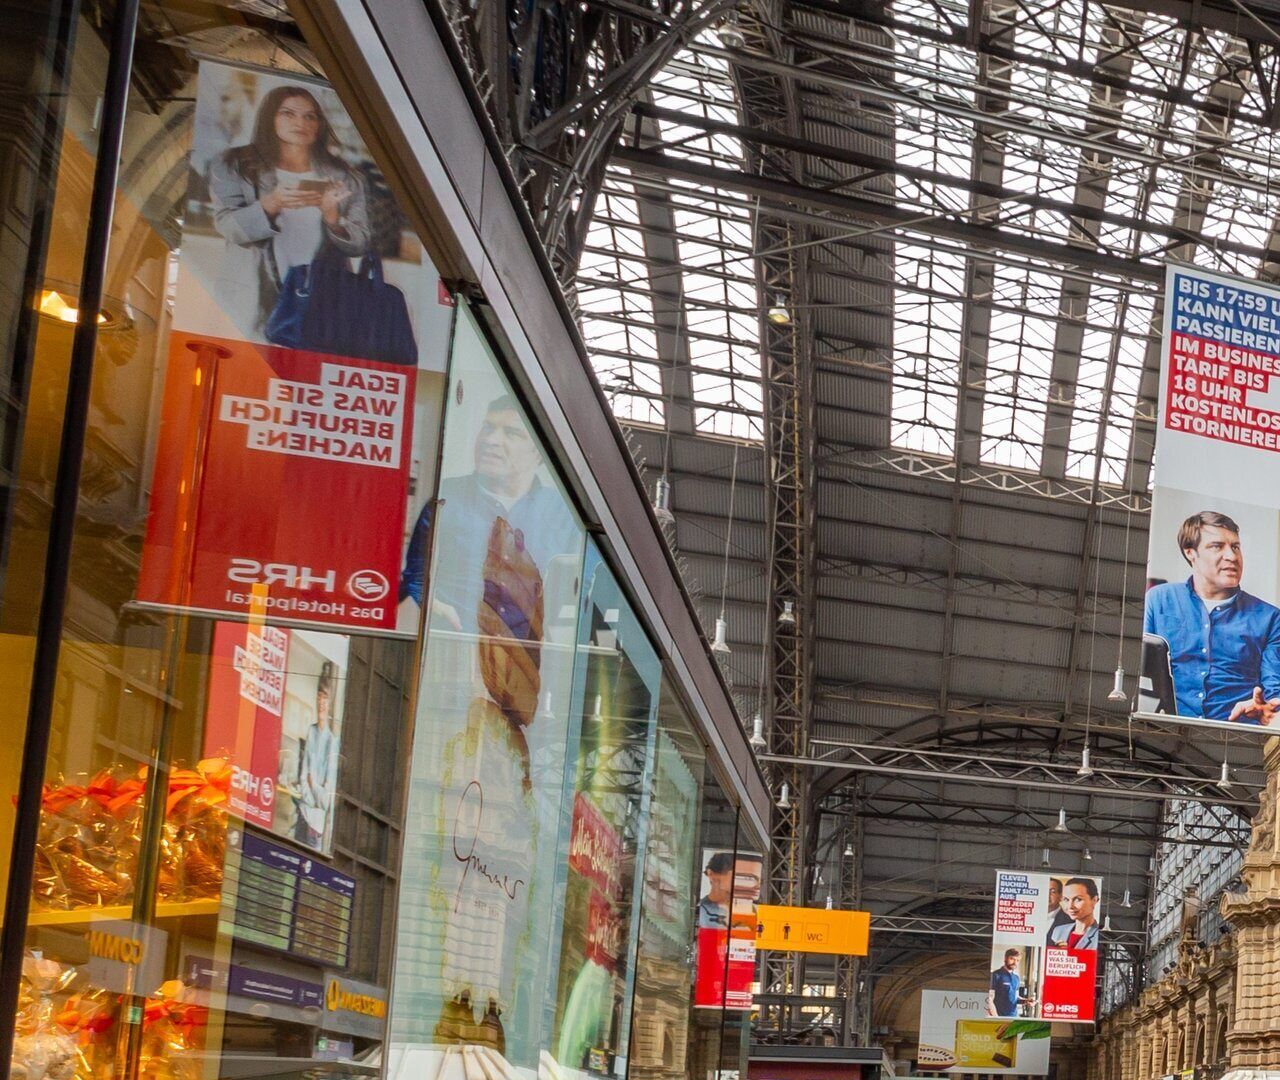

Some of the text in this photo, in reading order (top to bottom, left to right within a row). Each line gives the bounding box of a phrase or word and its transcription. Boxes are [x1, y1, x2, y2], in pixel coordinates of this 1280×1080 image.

[1178, 276, 1212, 299] BIS
[1215, 283, 1269, 312] 17:59
[1176, 296, 1280, 335] KANN VIEL
[1174, 335, 1200, 355] IM
[1173, 354, 1265, 389] TARIF BIS
[1173, 374, 1243, 404] 18 UHR
[1000, 874, 1027, 882] CLEVER
[998, 906, 1031, 914] BUCHUNG
[806, 933, 824, 942] WC
[1048, 963, 1085, 971] BERUFLICH
[942, 996, 979, 1010] Main
[1055, 1004, 1079, 1013] HRS
[961, 1034, 991, 1042] GOLD
